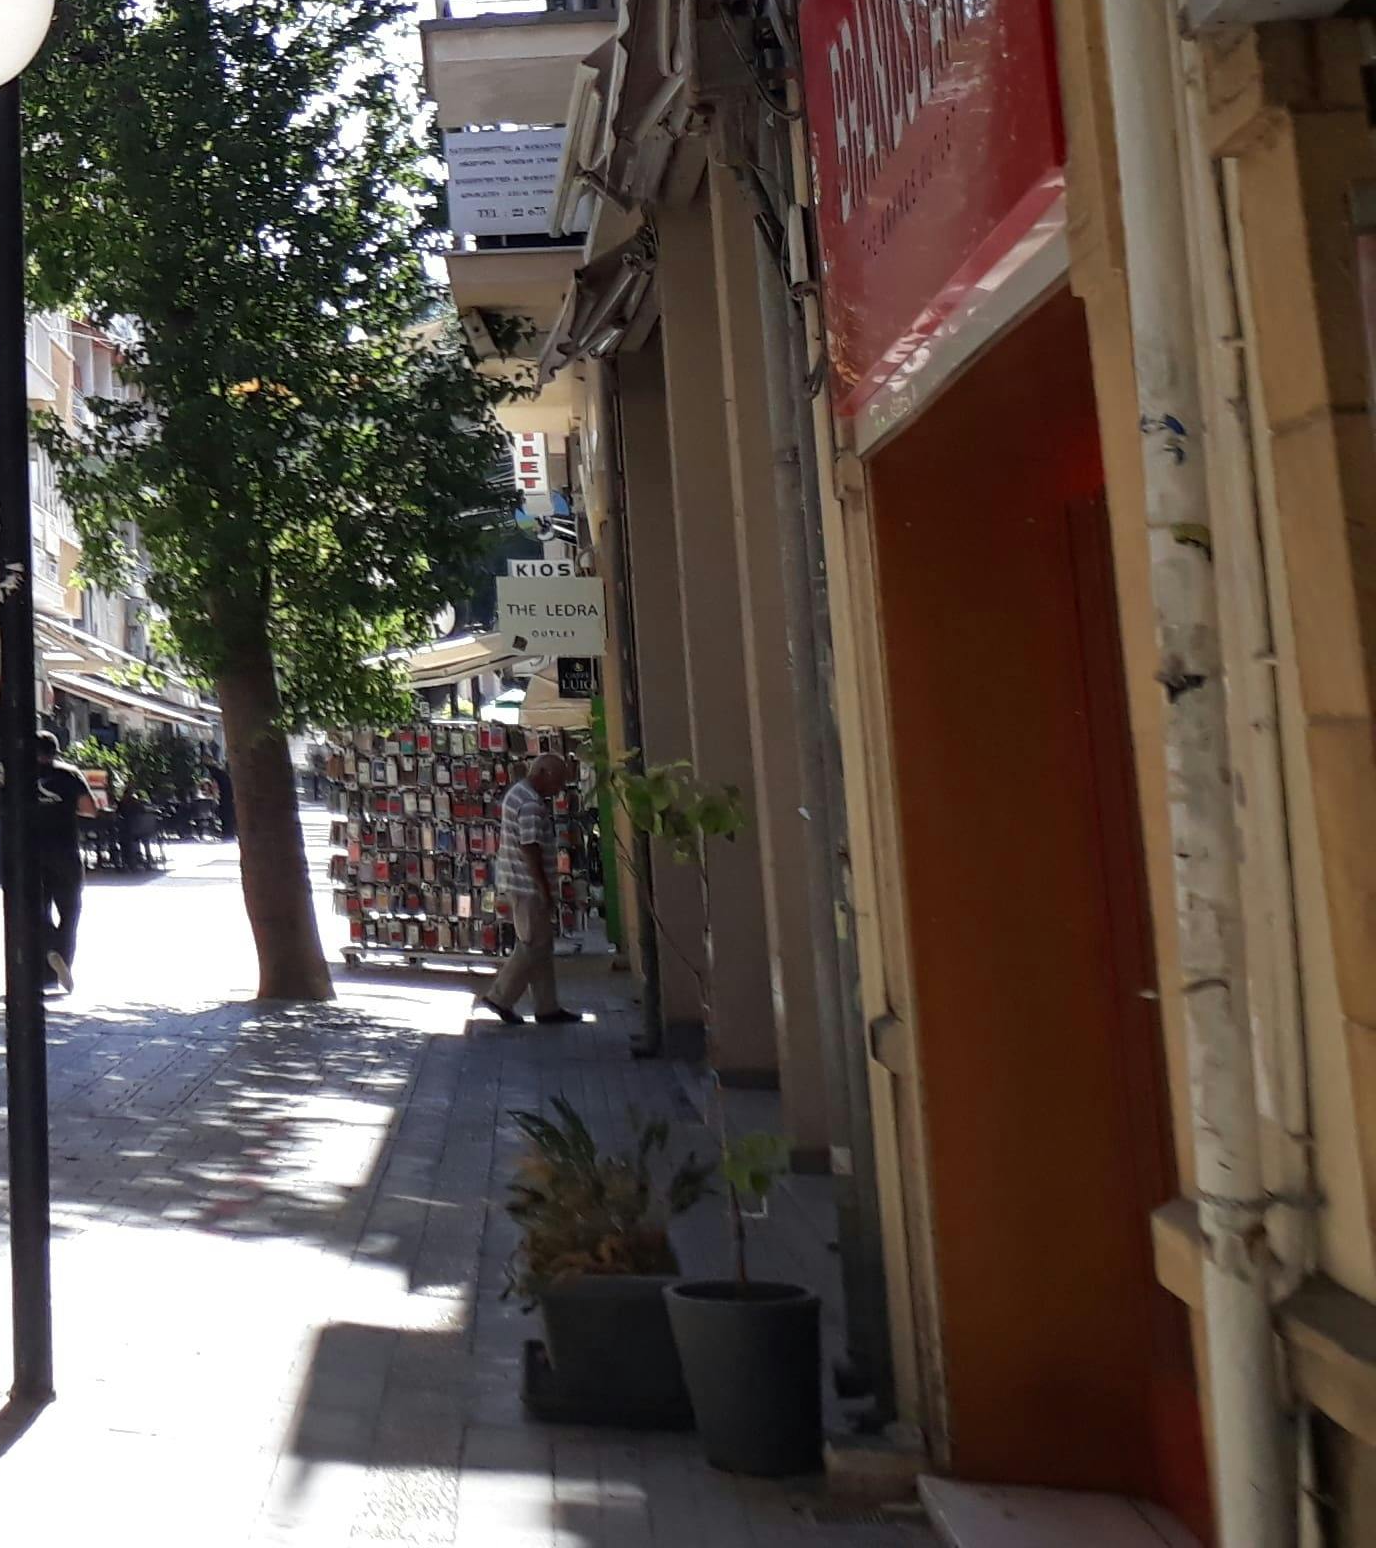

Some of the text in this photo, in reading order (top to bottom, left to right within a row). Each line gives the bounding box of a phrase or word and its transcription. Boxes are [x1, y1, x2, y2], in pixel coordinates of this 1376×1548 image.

[516, 563, 571, 577] KIOS
[507, 603, 599, 617] THE LEDRA
[531, 629, 576, 638] OUTLET
